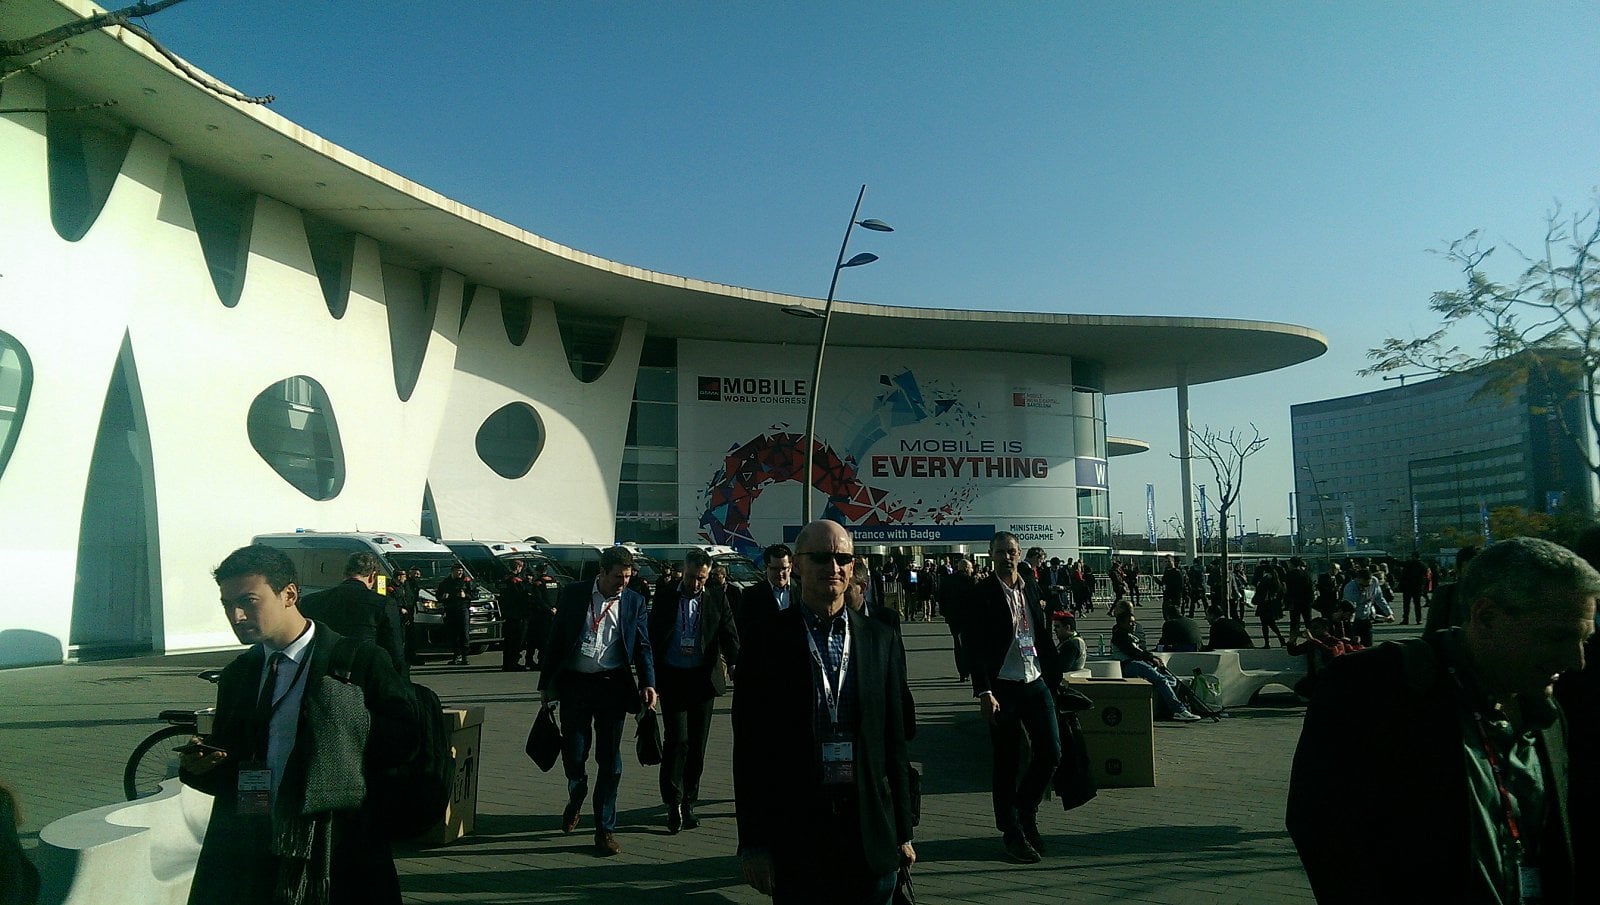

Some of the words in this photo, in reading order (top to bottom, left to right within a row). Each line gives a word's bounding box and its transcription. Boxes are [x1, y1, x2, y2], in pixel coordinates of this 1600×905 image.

[723, 378, 806, 396] MOBILE
[724, 395, 758, 403] WORLD
[760, 396, 807, 405] CONGRESS
[900, 439, 995, 453] MOBILE
[1003, 440, 1023, 453] IS
[871, 455, 1048, 479] EVERYTHING
[1094, 463, 1106, 485] W
[887, 529, 908, 539] with
[910, 529, 941, 540] Badge
[1009, 524, 1054, 532] MINISTERIAL
